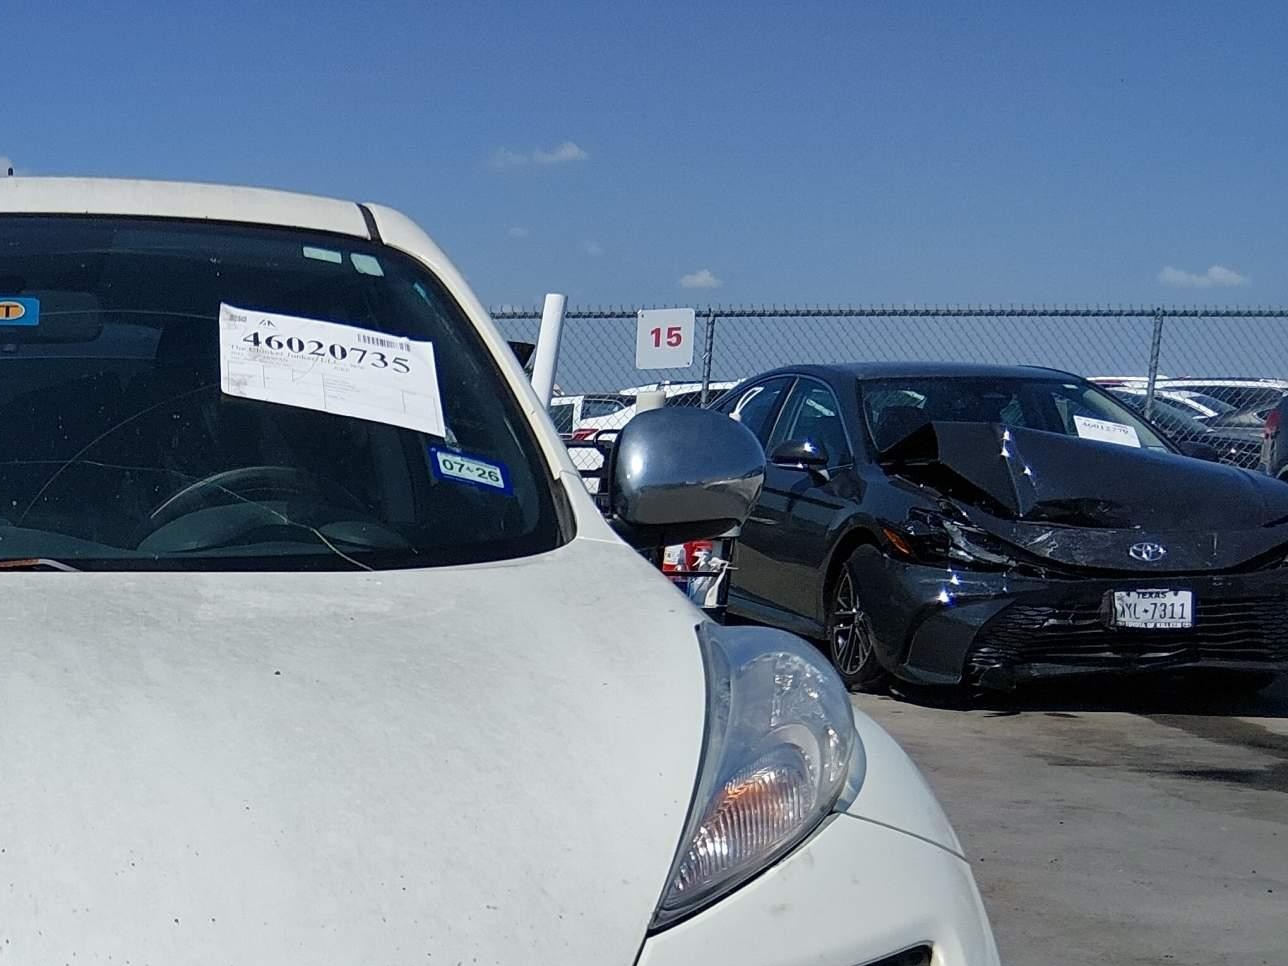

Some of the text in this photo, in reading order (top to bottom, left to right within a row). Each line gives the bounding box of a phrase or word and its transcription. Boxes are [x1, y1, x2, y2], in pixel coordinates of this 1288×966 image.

[650, 326, 682, 348] 15
[242, 331, 411, 374] 46020735
[1136, 590, 1168, 600] TEXAS
